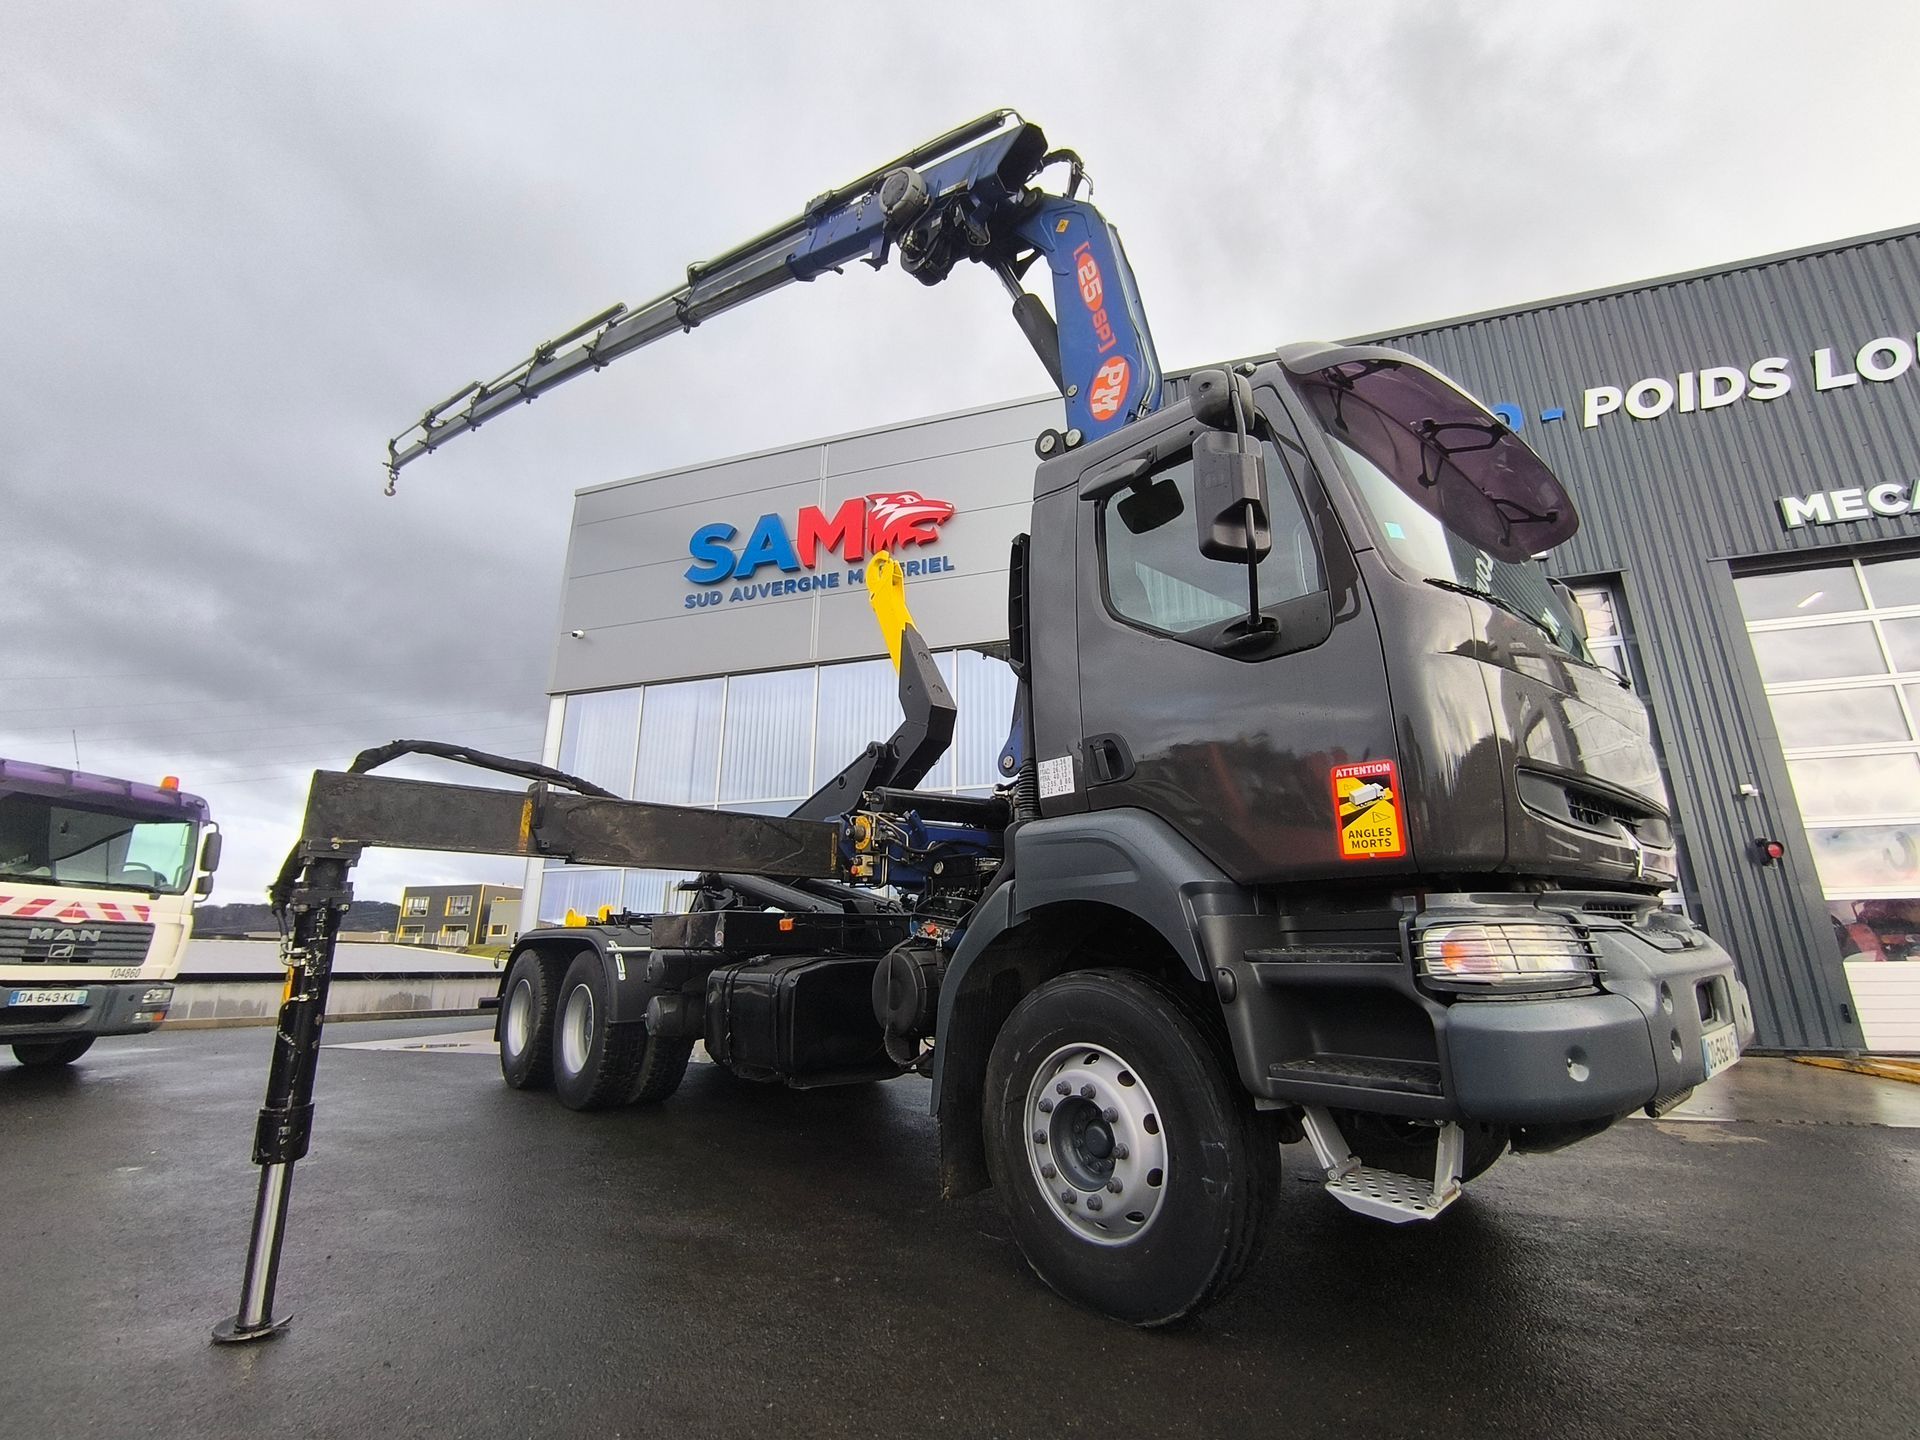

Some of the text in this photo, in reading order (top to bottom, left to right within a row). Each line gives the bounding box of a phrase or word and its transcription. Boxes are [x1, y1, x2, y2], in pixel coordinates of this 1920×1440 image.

[1092, 361, 1126, 414] PM
[1583, 356, 1792, 428] POIDS
[1814, 331, 1920, 391] LO
[1780, 480, 1920, 527] MEC
[684, 497, 867, 586] SAM
[684, 590, 723, 609] SUD
[729, 572, 840, 602] AUVERGNE
[1336, 762, 1391, 778] ATTENTION
[1348, 827, 1392, 839] ANGLES
[1351, 838, 1392, 849] MORTS
[28, 928, 101, 942] MAN
[109, 967, 141, 979] 104860
